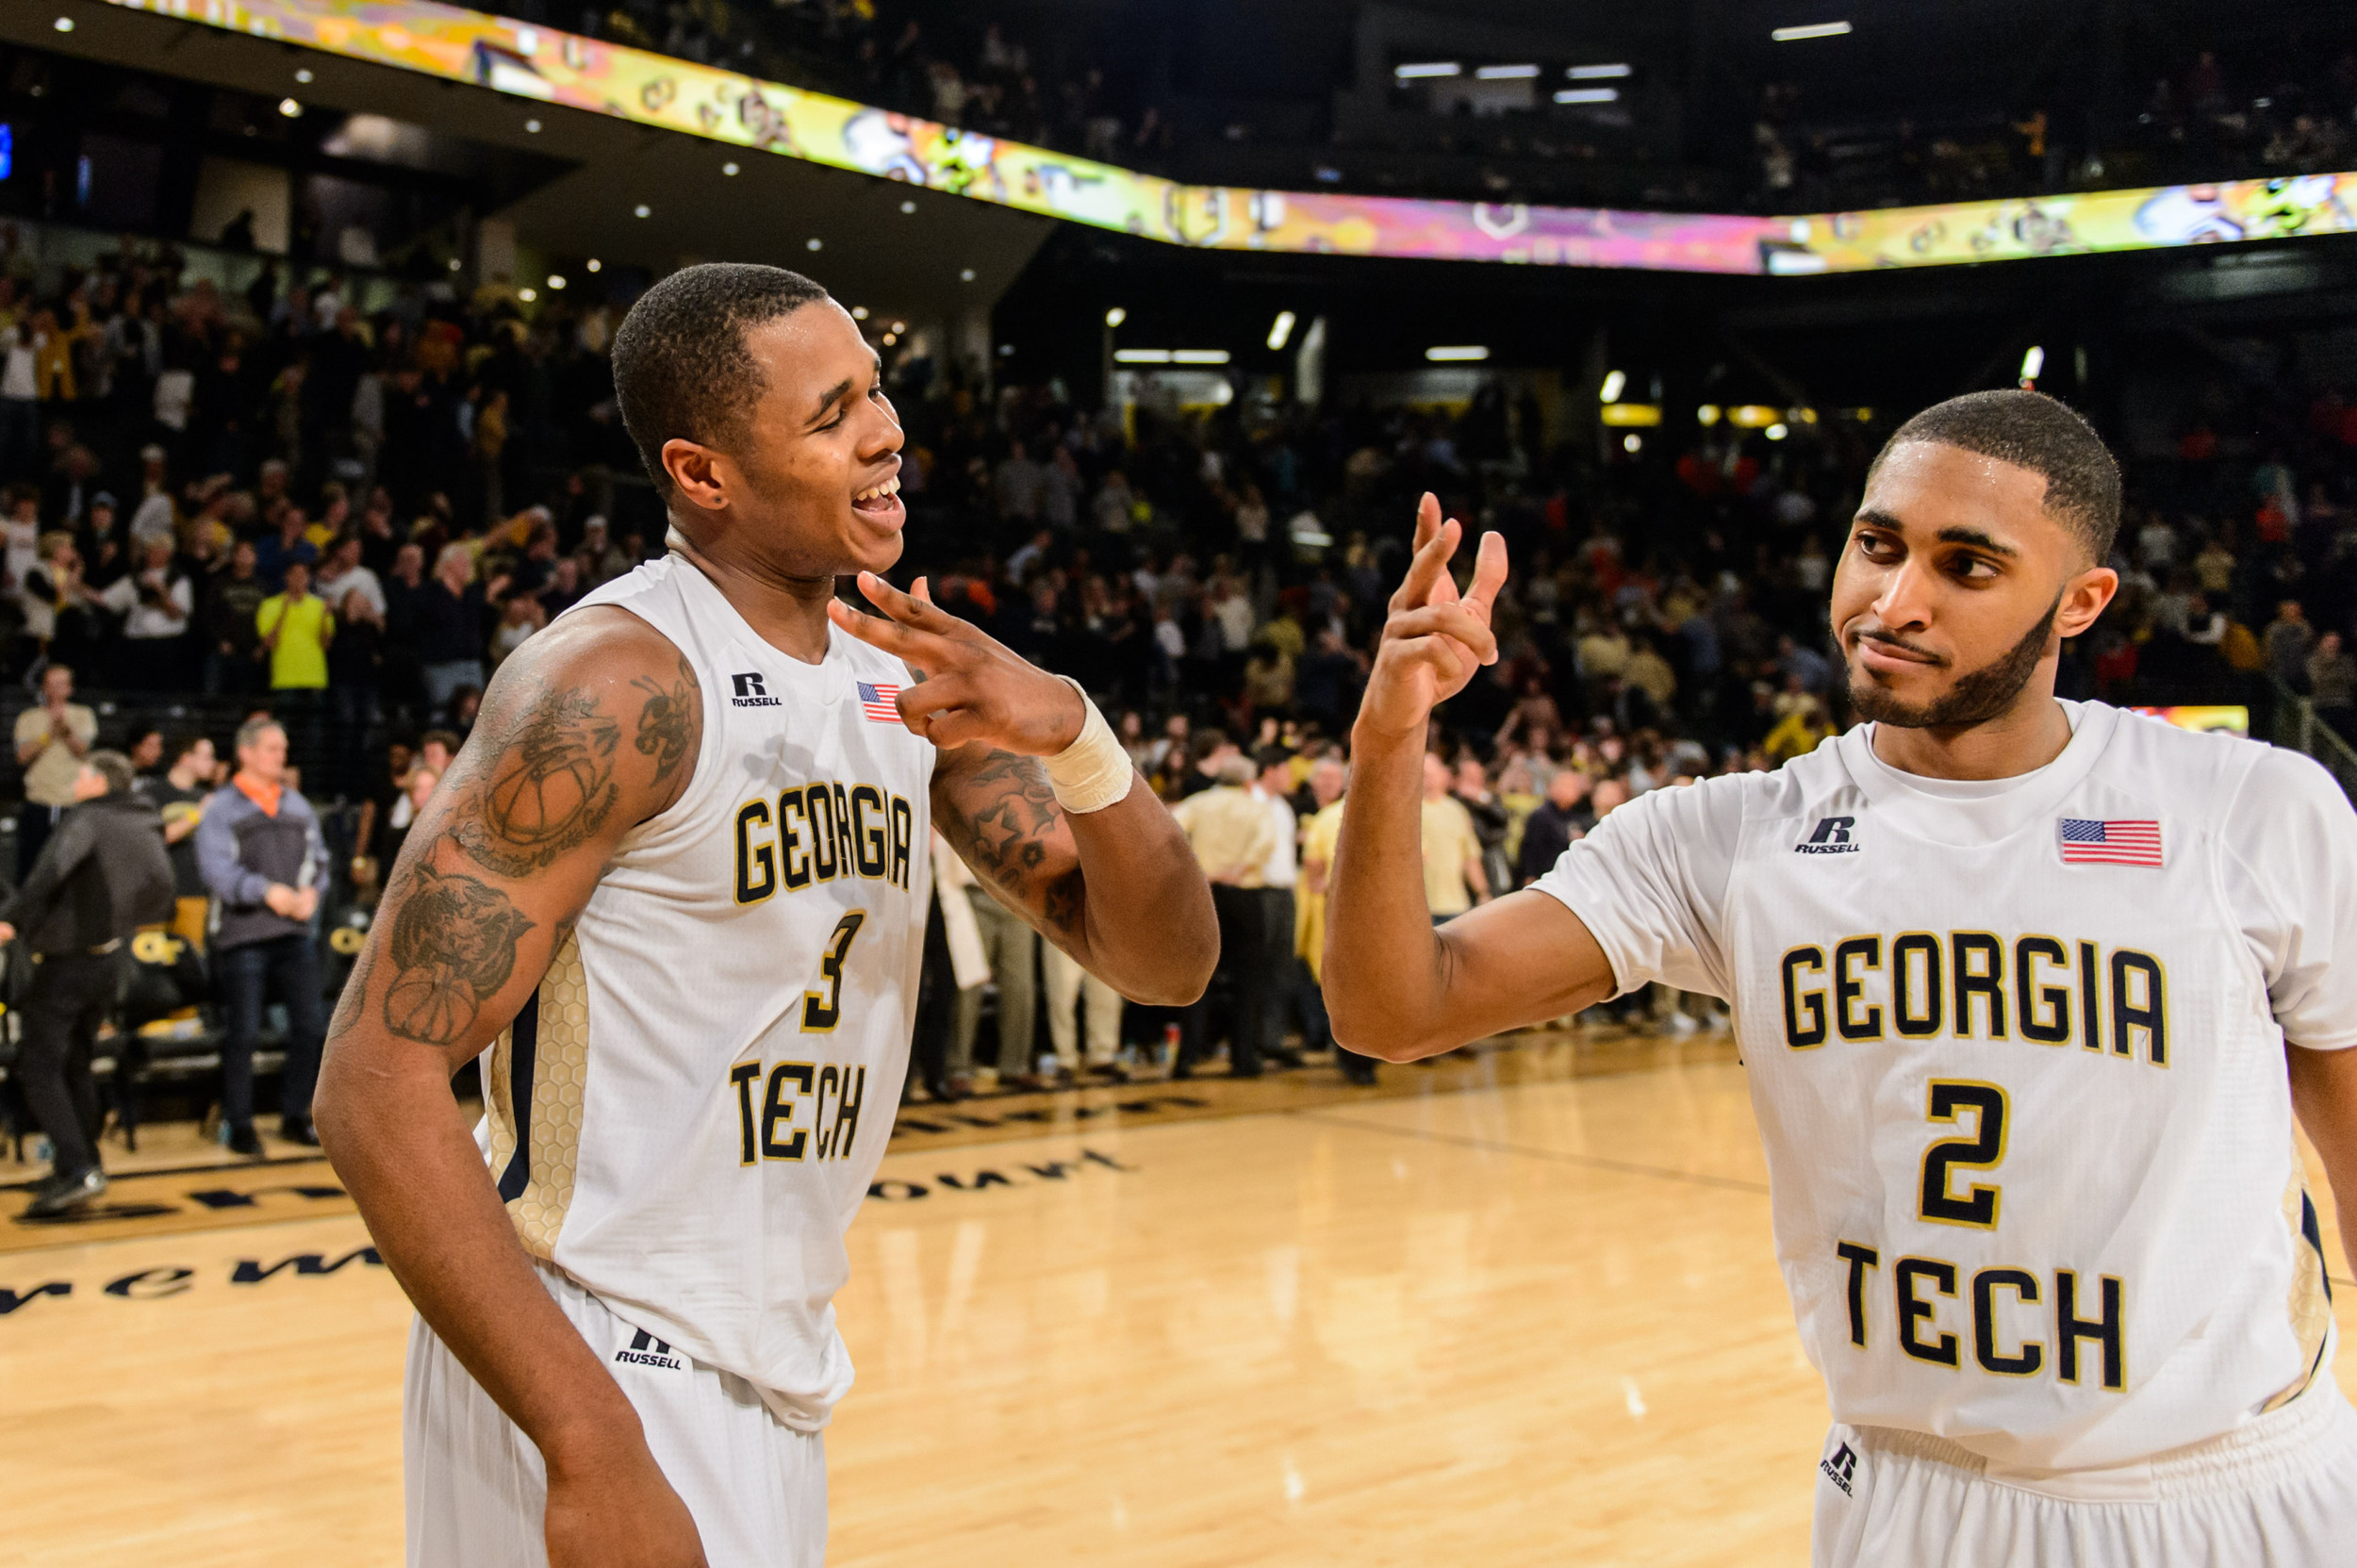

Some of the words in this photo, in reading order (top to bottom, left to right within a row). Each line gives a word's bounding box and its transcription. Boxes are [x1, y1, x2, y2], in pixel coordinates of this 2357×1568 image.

[732, 698, 783, 707] RUSSELL
[733, 780, 913, 906] GEORGIA
[1794, 843, 1861, 854] RUSSELL
[799, 908, 867, 1033] 3
[1781, 930, 2170, 1069] GEORGIA
[729, 1058, 867, 1168] TECH
[1917, 1077, 2011, 1231] 2
[615, 1350, 681, 1371] RUSSELL
[1836, 1237, 2128, 1394] TECH
